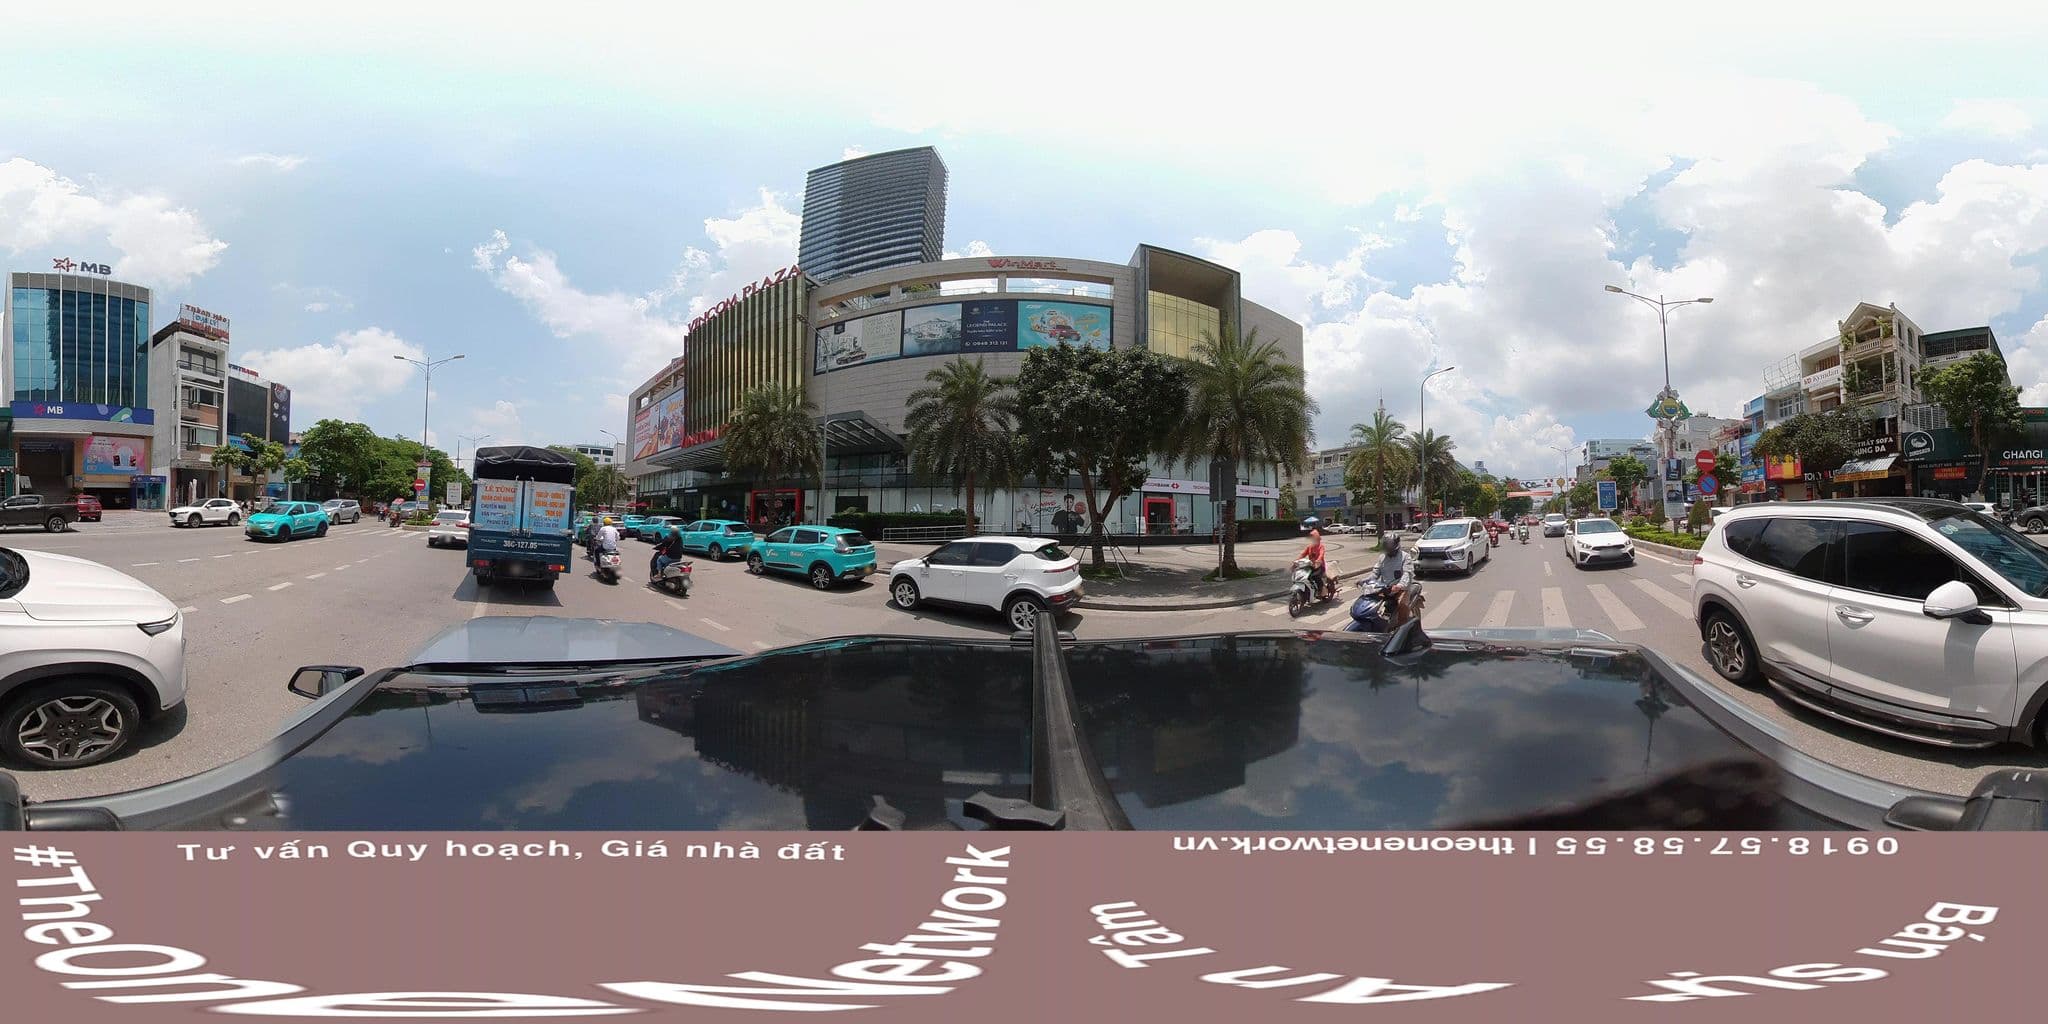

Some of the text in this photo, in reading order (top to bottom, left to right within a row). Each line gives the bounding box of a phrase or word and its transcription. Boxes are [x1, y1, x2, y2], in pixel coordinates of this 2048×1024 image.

[80, 261, 111, 275] MB
[688, 264, 800, 331] VINCOM PLAZA
[47, 406, 63, 414] MB
[1875, 436, 1893, 445] SOFA
